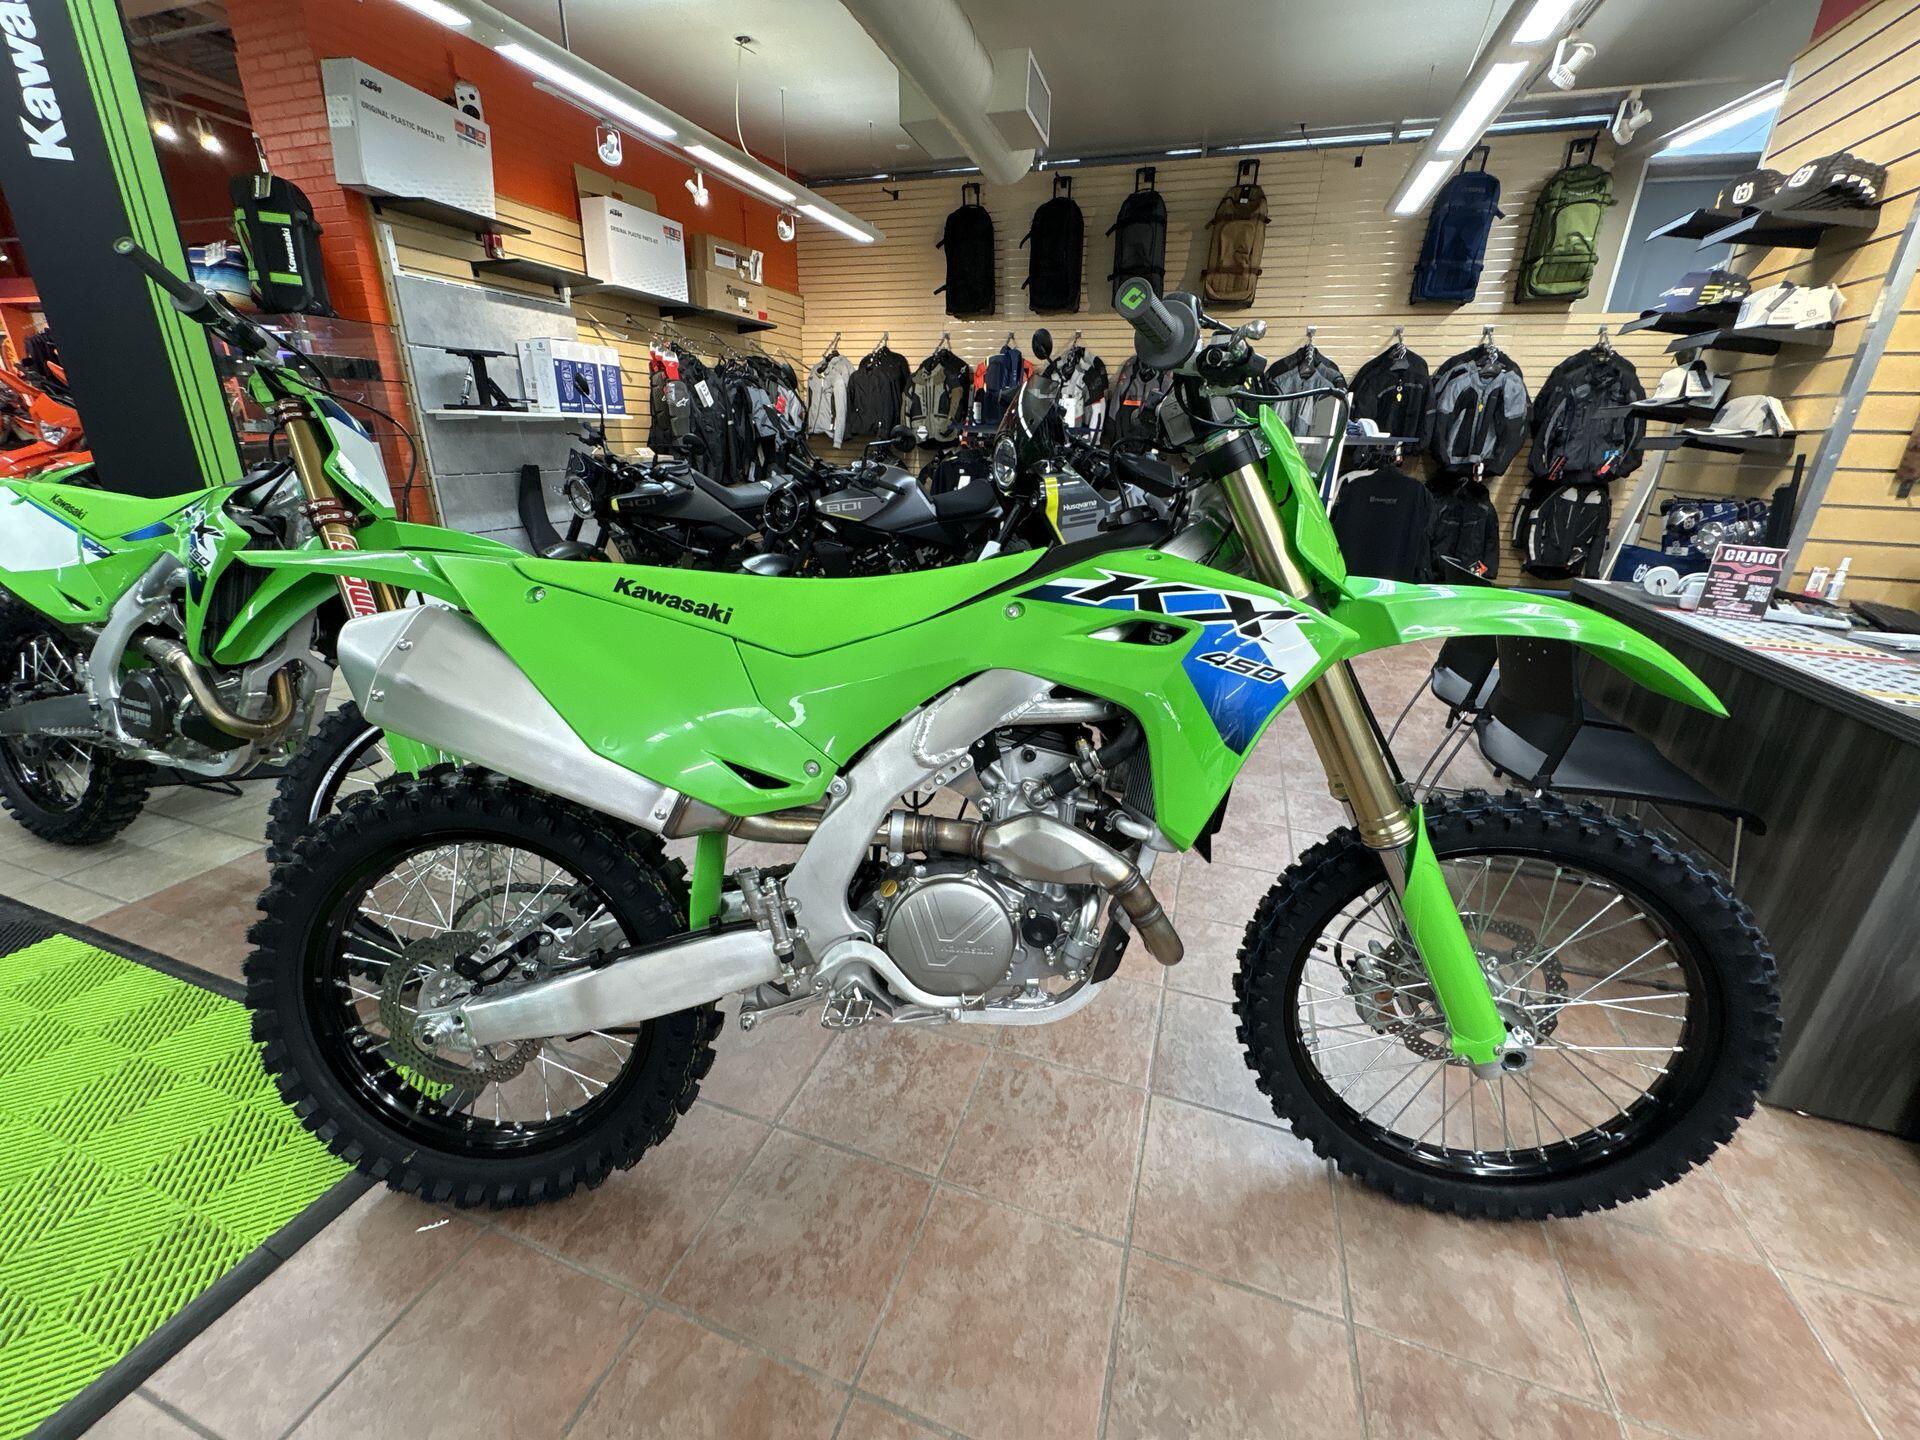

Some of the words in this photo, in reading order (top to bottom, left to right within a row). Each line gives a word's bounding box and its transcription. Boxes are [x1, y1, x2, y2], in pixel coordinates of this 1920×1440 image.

[360, 101, 390, 119] ORIGINAL
[390, 114, 416, 131] PLASTIC
[416, 125, 436, 139] PARTS
[436, 132, 446, 143] KIT
[610, 225, 628, 235] ORIGINAL
[281, 227, 298, 273] Kawasaki
[49, 493, 88, 521] Kawasaki
[1063, 500, 1098, 511] Husqvarna
[1723, 549, 1778, 565] CRAIG
[613, 577, 734, 625] Kawasaki
[1195, 650, 1287, 684] 450
